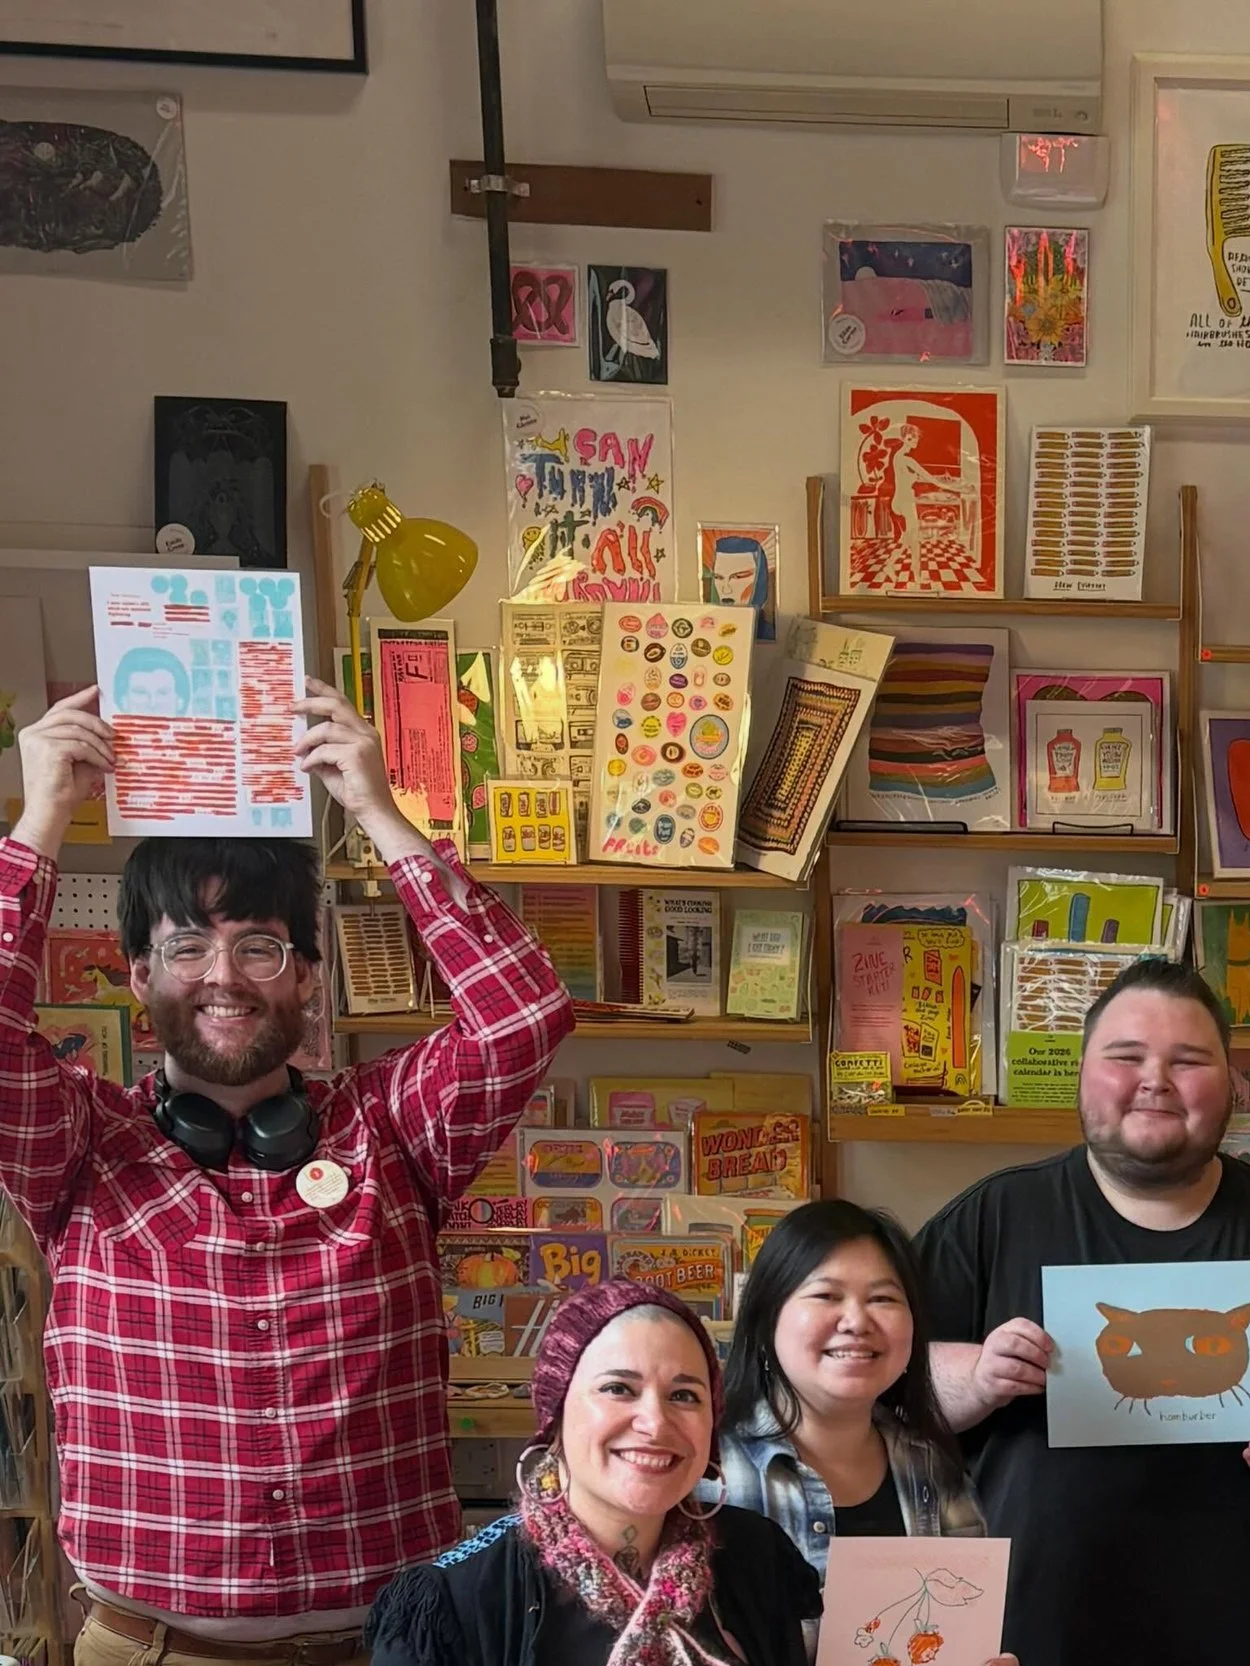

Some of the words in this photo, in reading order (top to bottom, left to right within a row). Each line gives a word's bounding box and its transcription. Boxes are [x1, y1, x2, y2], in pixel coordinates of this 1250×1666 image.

[1189, 313, 1211, 328] ALL
[852, 950, 888, 973] ZINE
[1028, 1047, 1046, 1056] Our
[1011, 1057, 1069, 1067] collaborative
[1013, 1067, 1052, 1076] calendar
[706, 1149, 788, 1181] BREAD
[539, 1242, 602, 1286] Big
[676, 1264, 715, 1283] BEER
[473, 1294, 496, 1310] BIG
